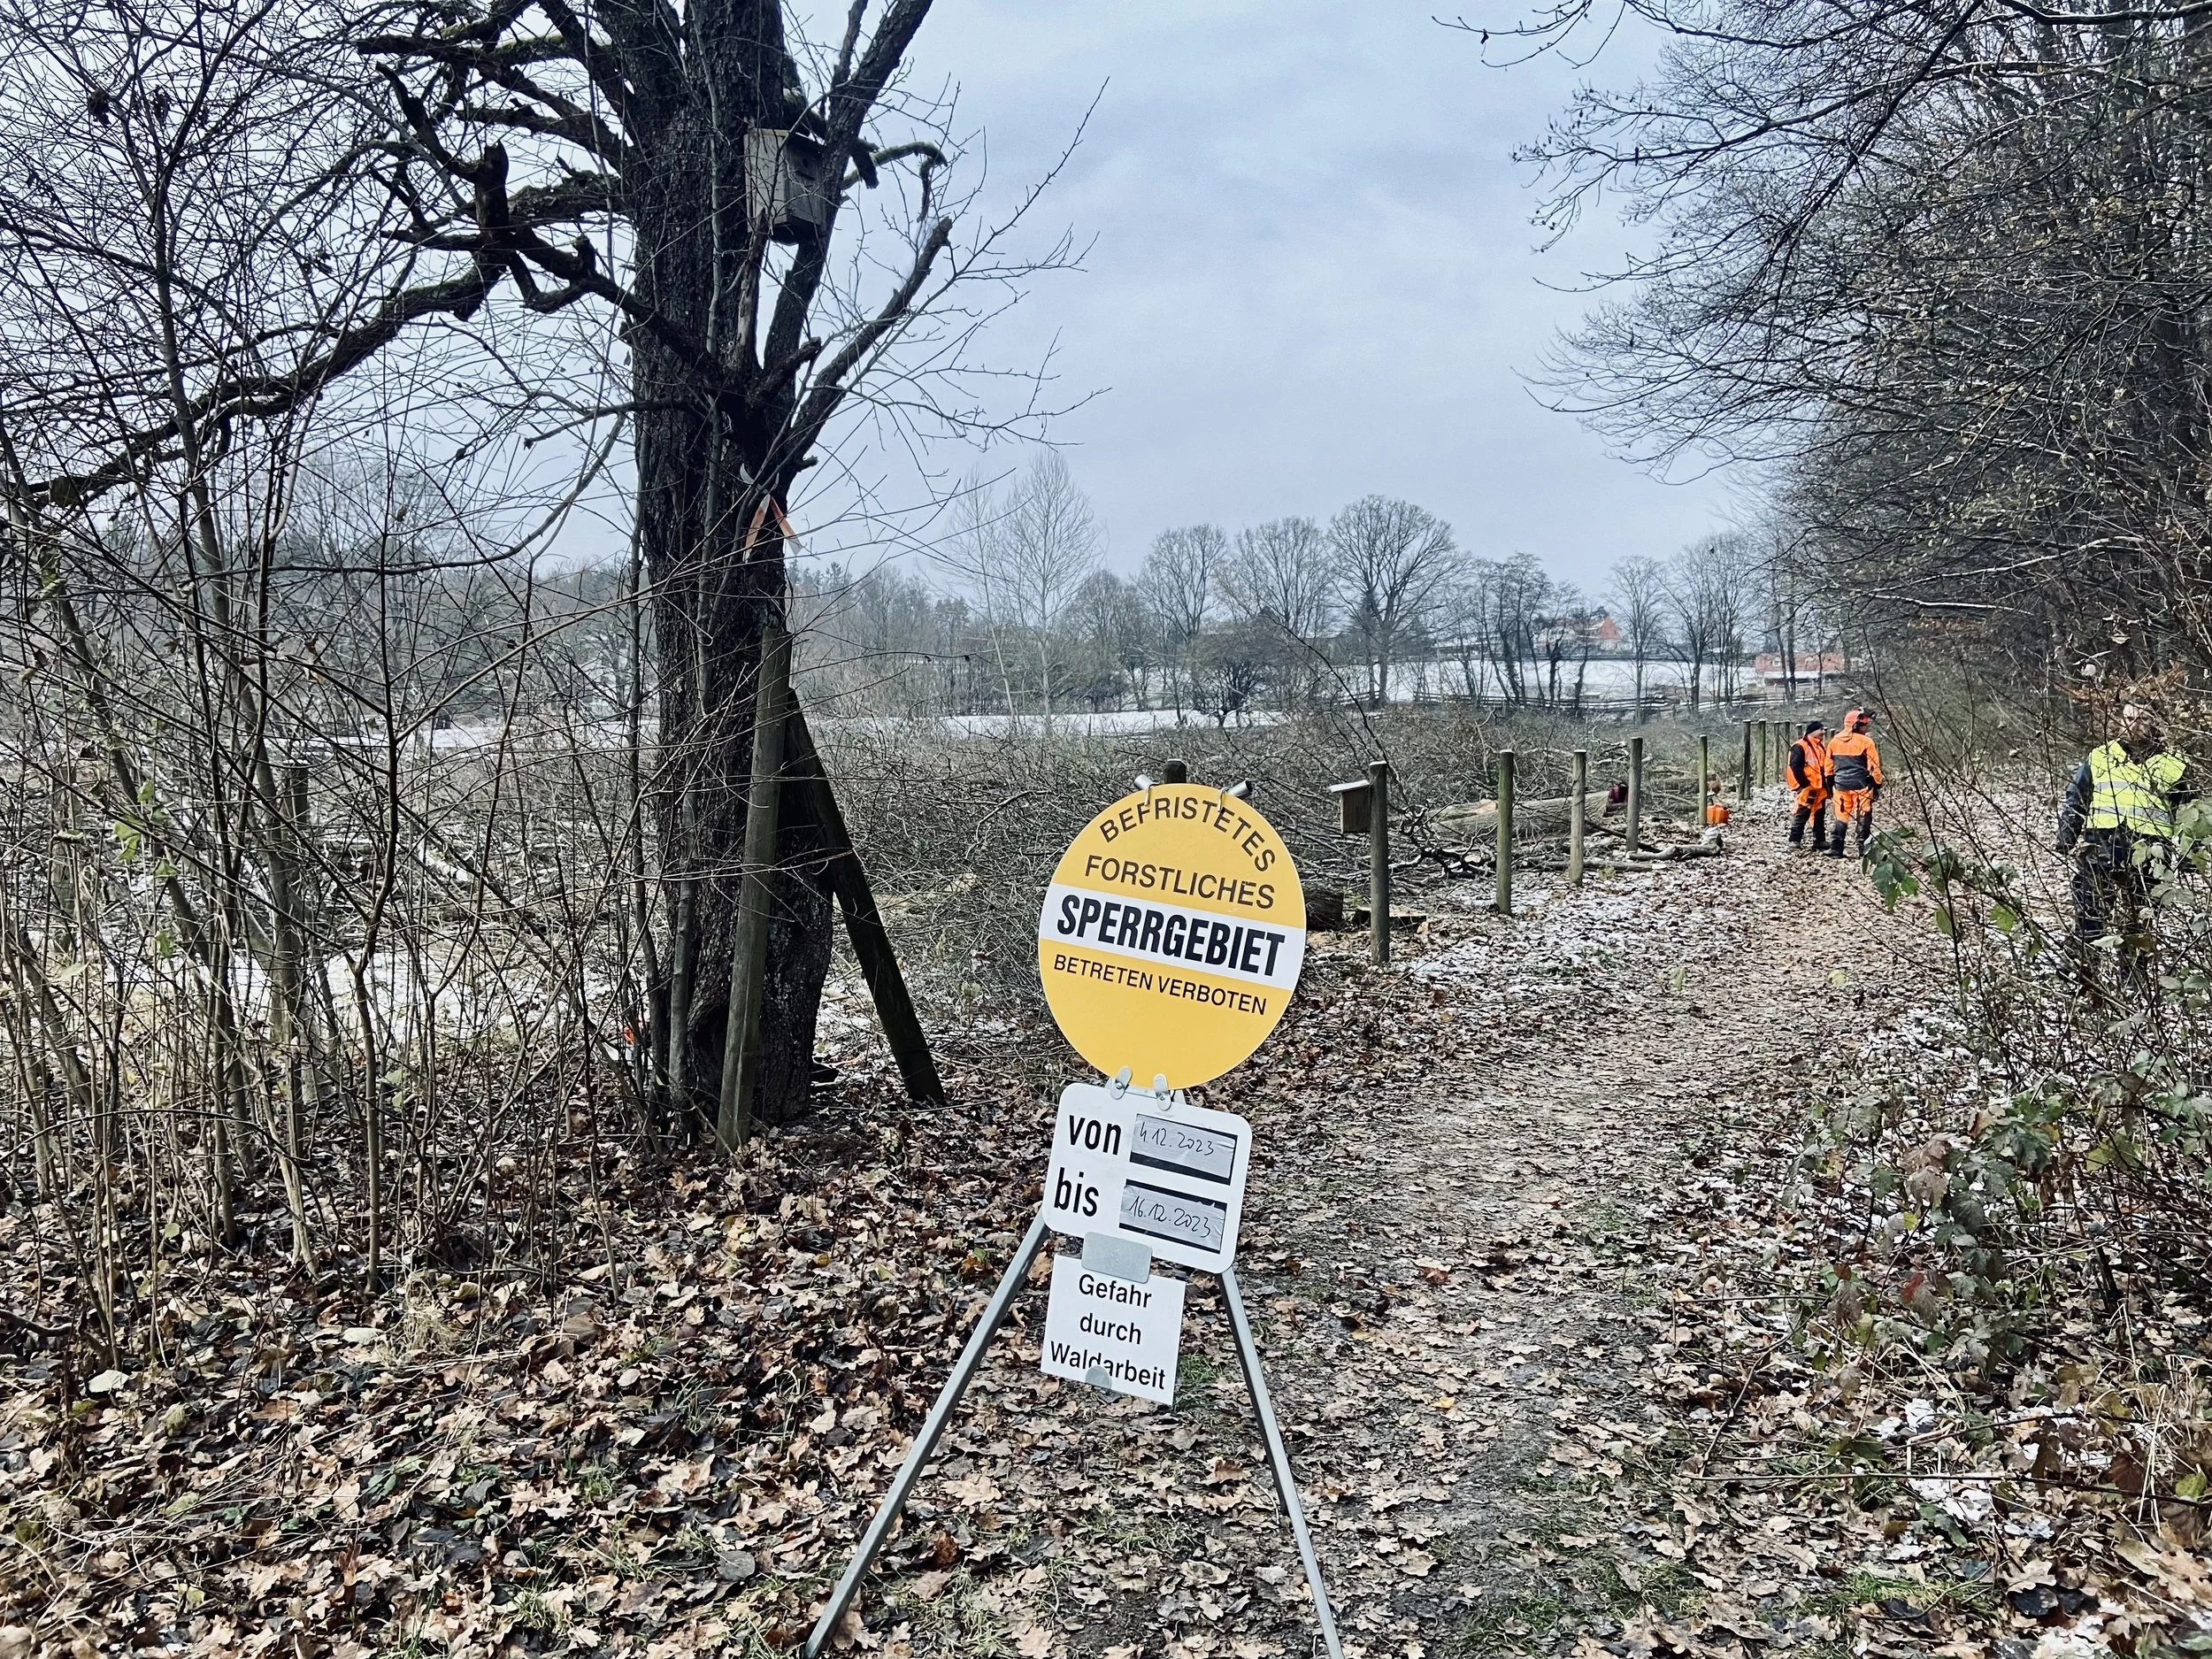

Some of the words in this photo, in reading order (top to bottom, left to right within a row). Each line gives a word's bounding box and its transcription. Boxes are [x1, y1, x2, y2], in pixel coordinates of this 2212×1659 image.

[1100, 796, 1276, 872] BEFRISTETES
[1085, 855, 1275, 910] FORSTLICHES
[1057, 894, 1286, 977] SPERRGEBIET
[1054, 954, 1153, 990] BETRETEN
[1158, 975, 1267, 1016] VERBOTEN
[1069, 1115, 1122, 1156] von
[1054, 1166, 1100, 1217] bis
[1079, 1273, 1152, 1309] Gefahr
[1079, 1313, 1141, 1345] durch
